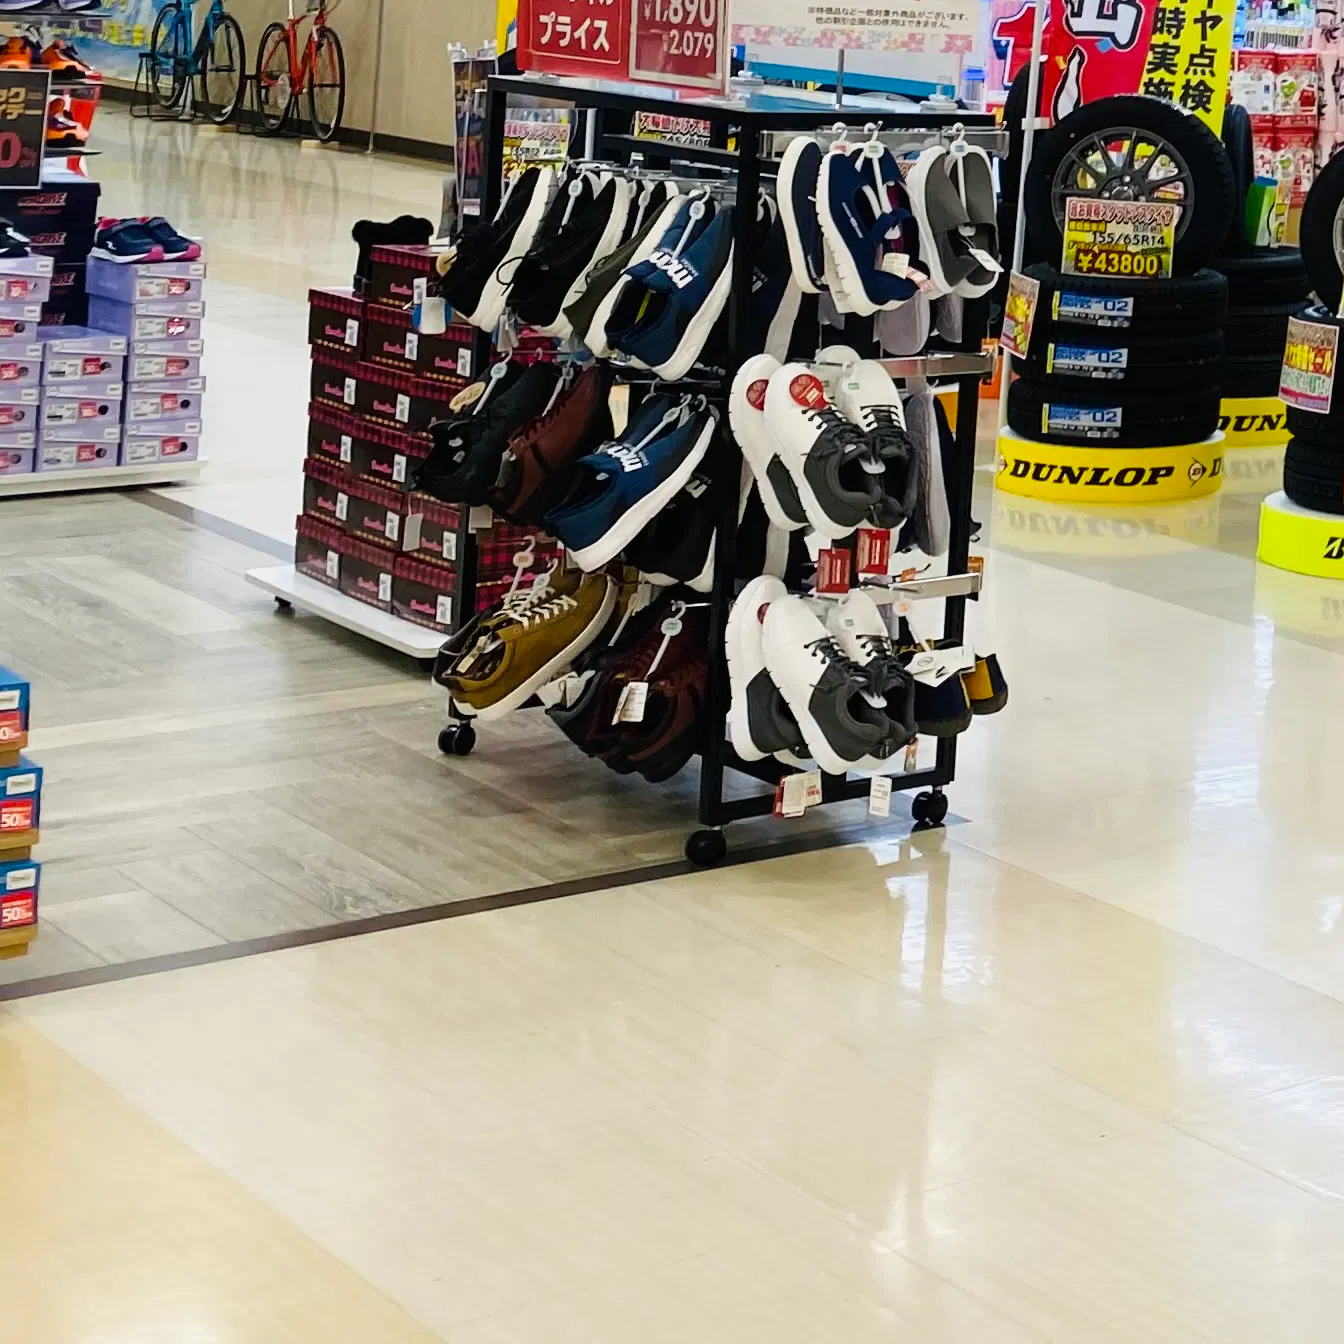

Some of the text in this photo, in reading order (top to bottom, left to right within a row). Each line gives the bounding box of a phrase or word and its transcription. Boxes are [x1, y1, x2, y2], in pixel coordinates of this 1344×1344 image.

[539, 11, 610, 52] プライス
[1078, 252, 1159, 275] ¥43800
[1010, 458, 1175, 487] DUNLOP
